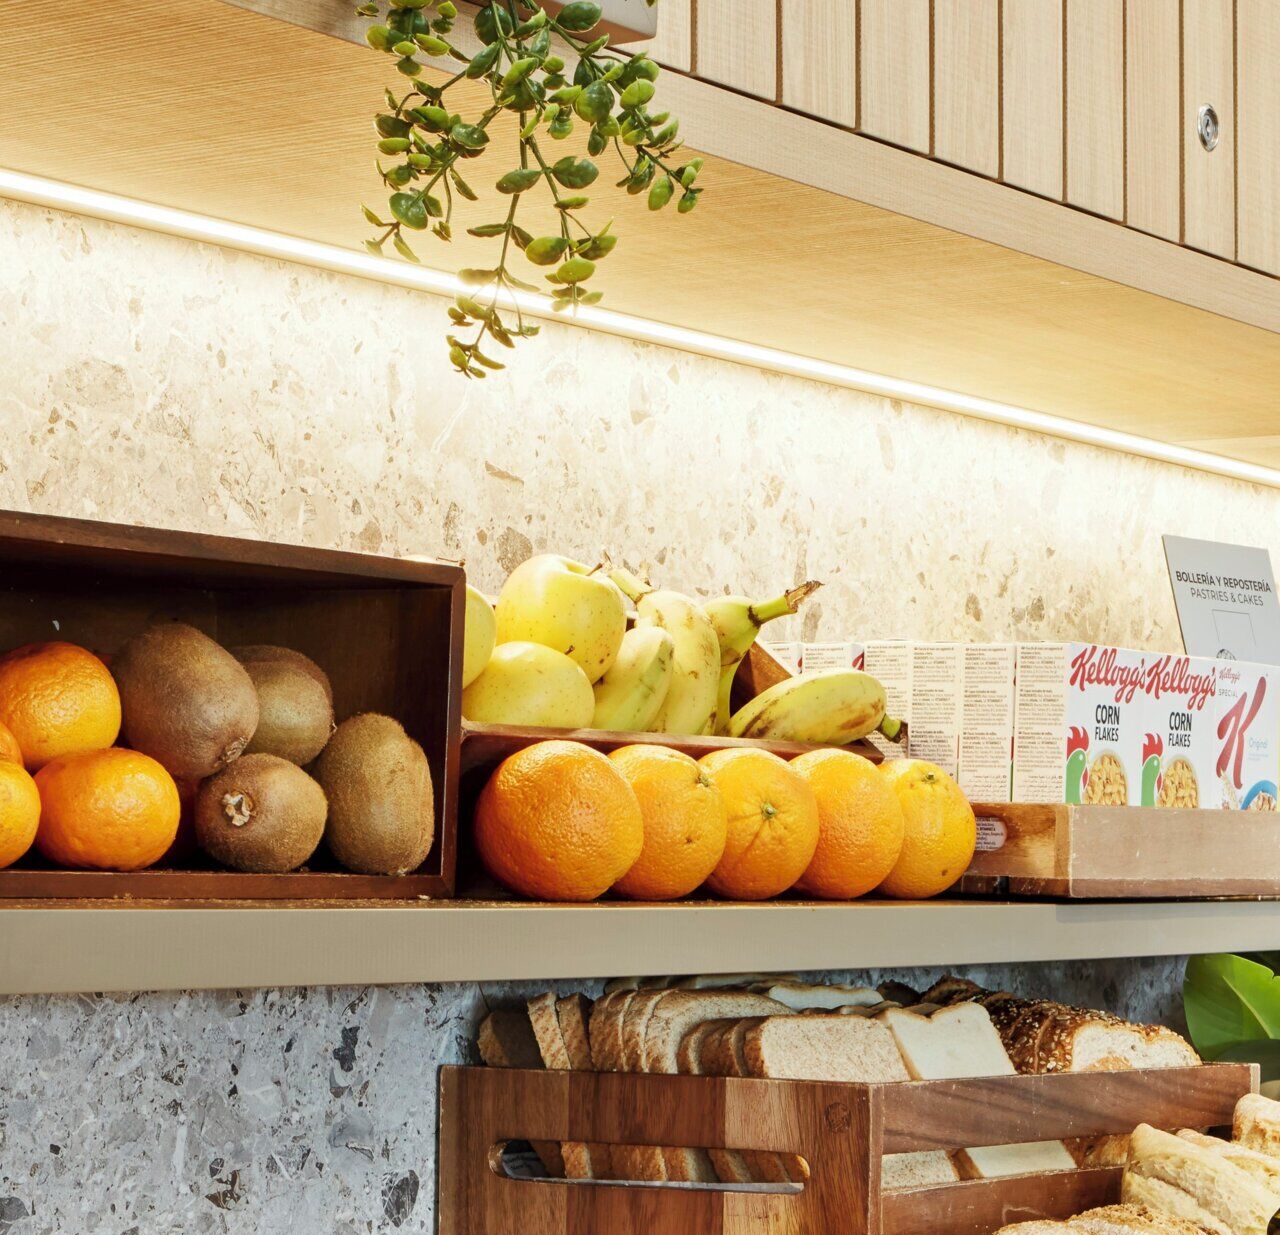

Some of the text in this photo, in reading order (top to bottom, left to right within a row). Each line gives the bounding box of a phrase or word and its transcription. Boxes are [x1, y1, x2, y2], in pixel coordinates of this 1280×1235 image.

[1175, 570, 1272, 593] BOLLERÍA Y REPOSTERÍA
[1190, 587, 1264, 607] PASTRIES & CAKES
[1069, 645, 1146, 704] Kellogg's
[1145, 655, 1217, 711] Kellogg's
[1218, 688, 1239, 698] SPECIAL
[1095, 704, 1121, 725] CORN
[1169, 711, 1193, 732] CORN
[1094, 726, 1119, 742] FLAKES
[1168, 733, 1191, 748] FLAKES
[1216, 676, 1267, 790] K
